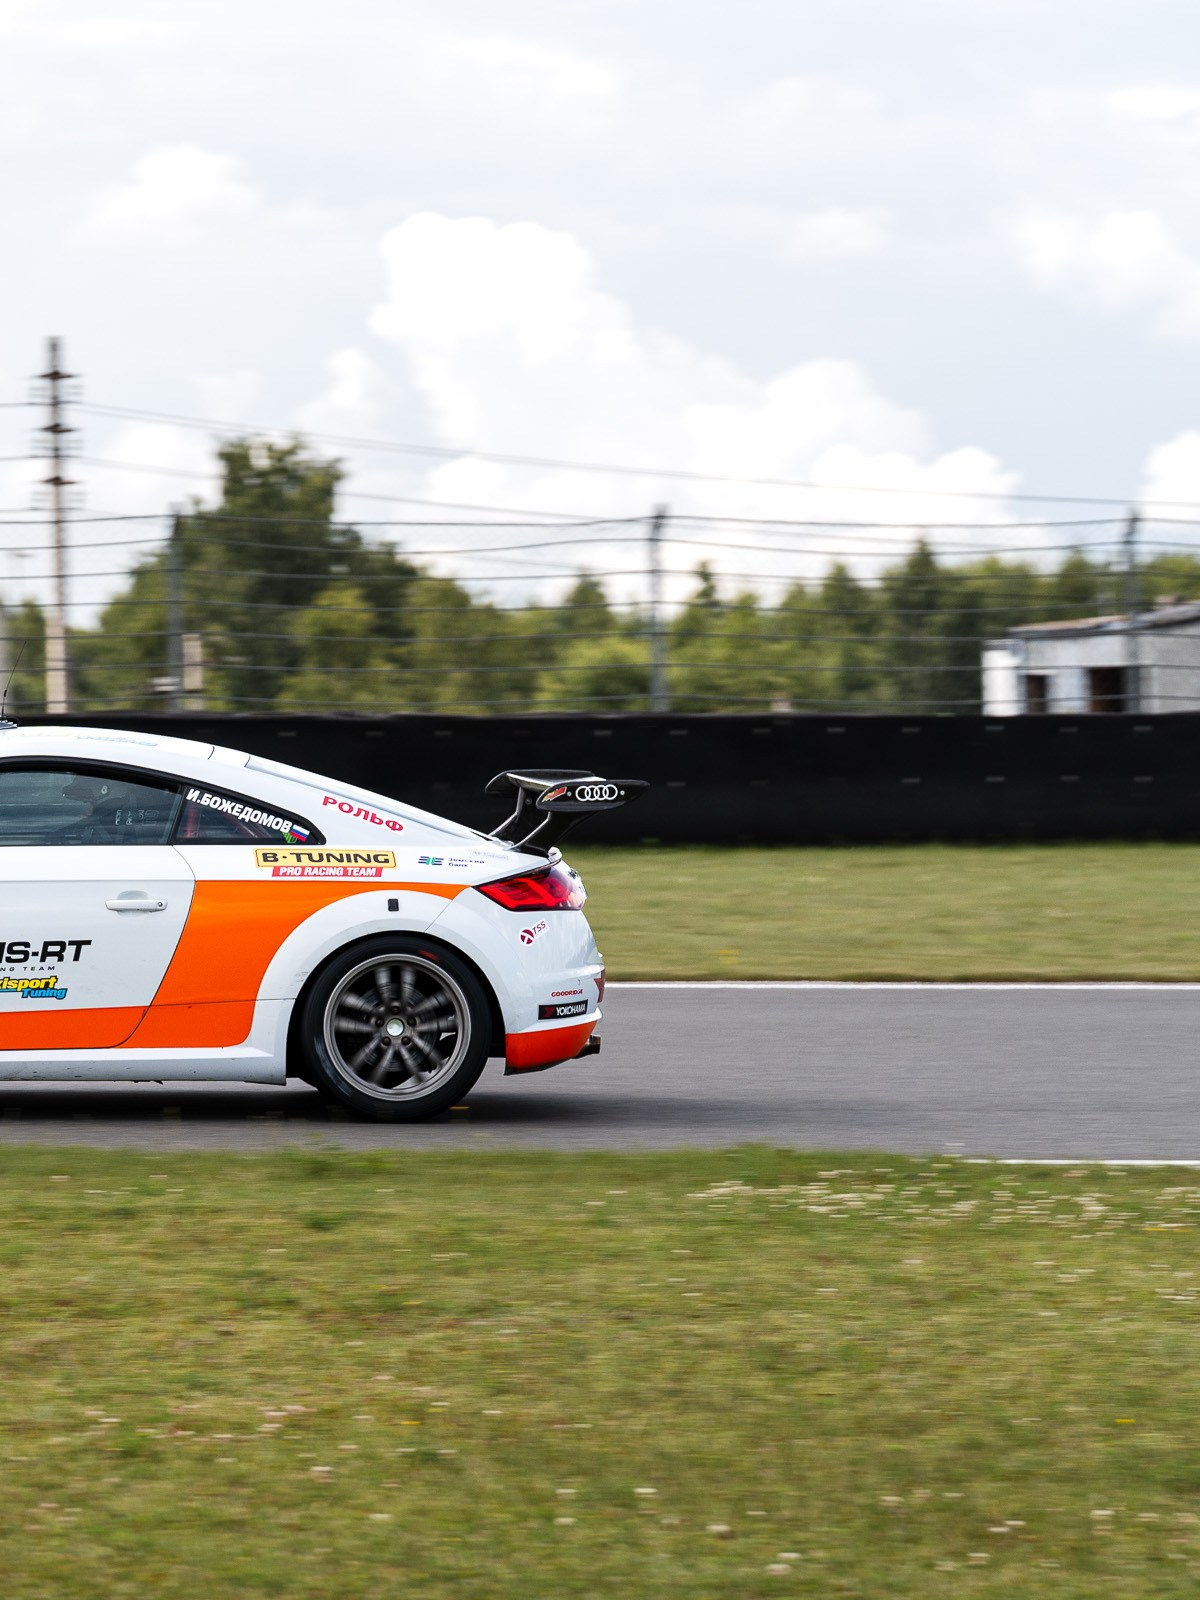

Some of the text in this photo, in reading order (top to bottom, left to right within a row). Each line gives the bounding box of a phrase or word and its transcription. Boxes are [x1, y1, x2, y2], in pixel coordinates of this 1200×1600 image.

[186, 788, 293, 833] И.БОЖЕДОМОВ
[322, 795, 404, 832] РОЛЬФ
[279, 866, 377, 877] PRO RACING TEAM
[532, 920, 547, 935] TSS
[21, 988, 68, 1000] Tuning
[556, 1003, 586, 1016] YOKOHAMA
